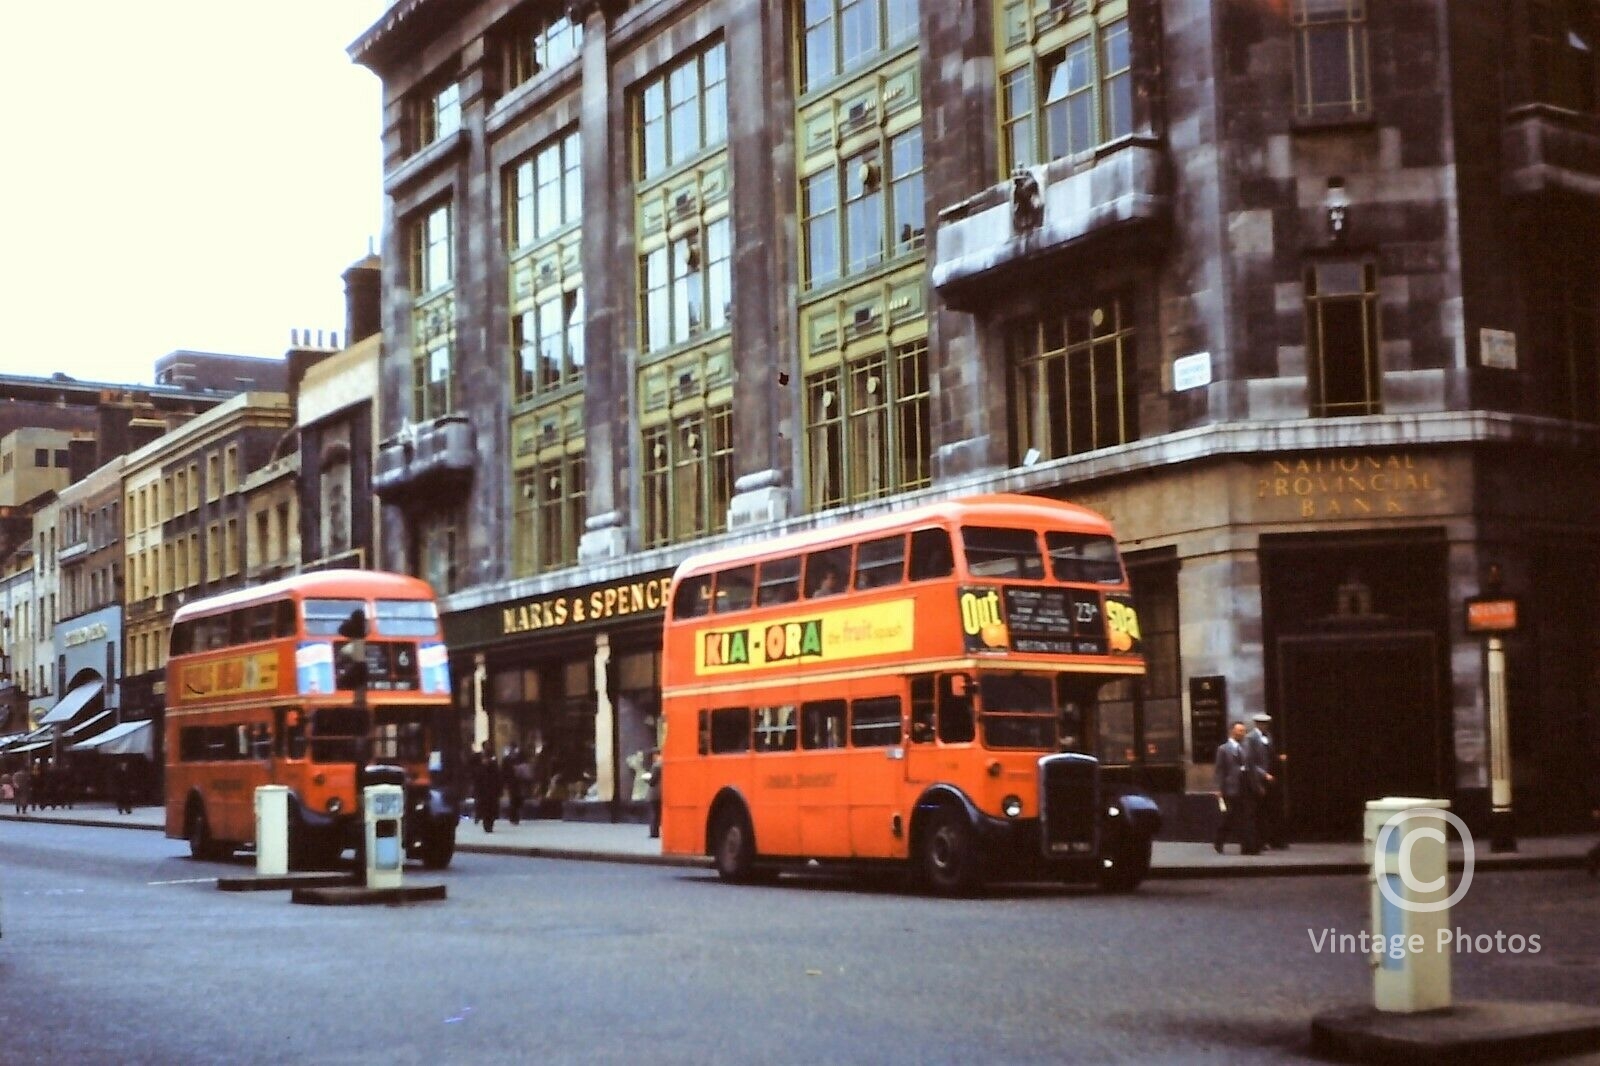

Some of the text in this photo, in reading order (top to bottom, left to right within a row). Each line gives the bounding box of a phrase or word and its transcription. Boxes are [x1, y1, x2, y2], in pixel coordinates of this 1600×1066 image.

[1273, 455, 1415, 475] NATIONAL
[1257, 471, 1433, 498] PROVINCIAL
[1301, 497, 1403, 518] BANK
[503, 597, 569, 634] MARKS
[572, 598, 586, 623] &
[960, 591, 1002, 635] Out
